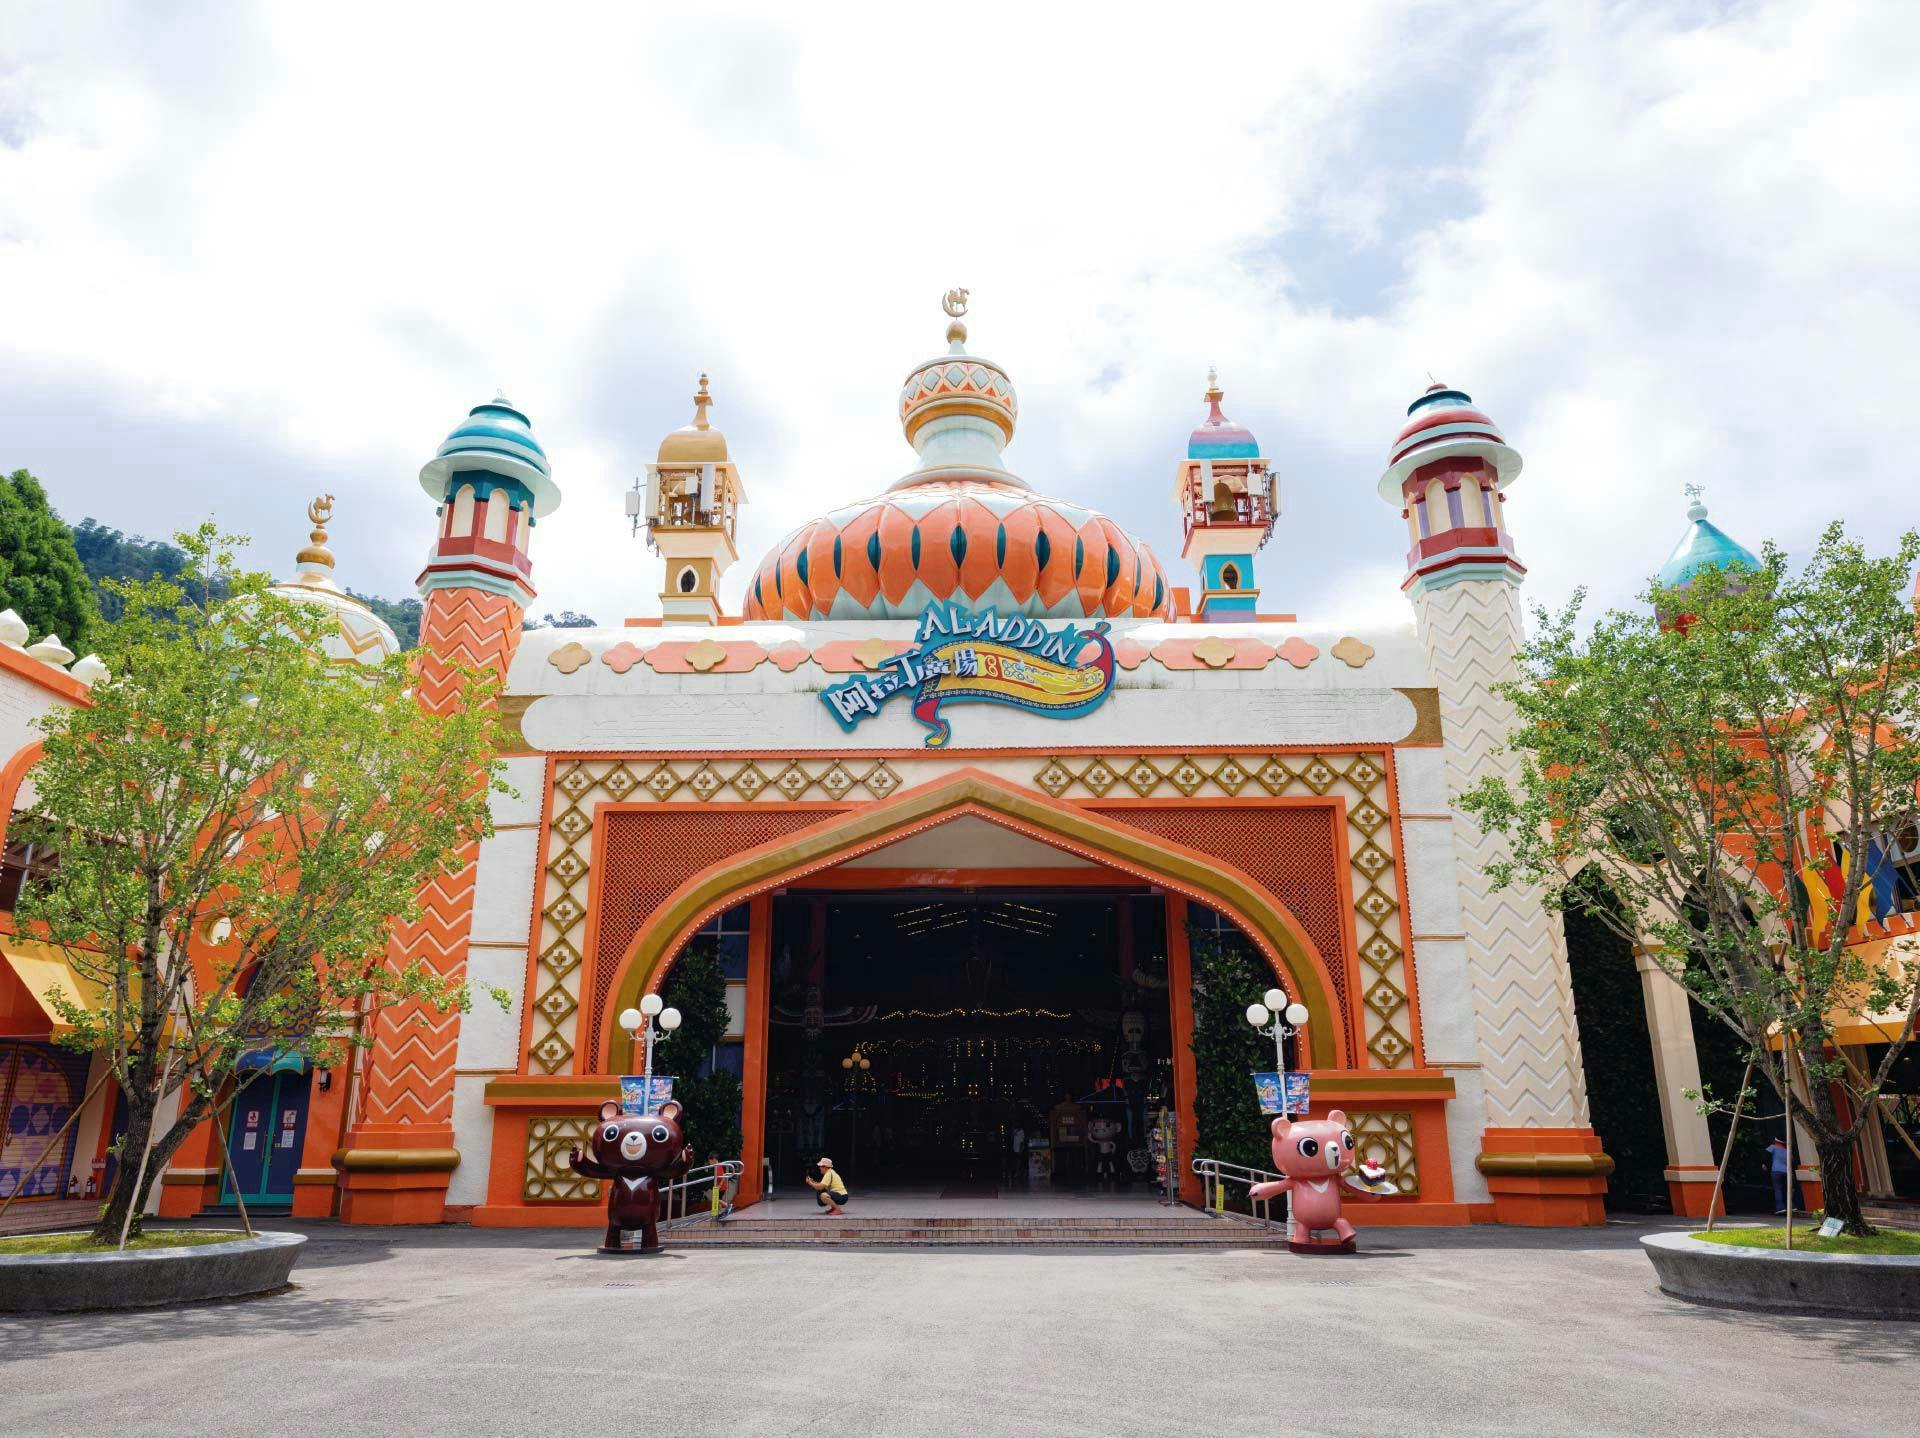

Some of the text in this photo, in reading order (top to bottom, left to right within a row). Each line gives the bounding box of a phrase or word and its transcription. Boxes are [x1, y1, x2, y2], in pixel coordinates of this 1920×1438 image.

[921, 607, 1076, 664] ALADDIN
[827, 648, 978, 723] 阿拉丁廣場
